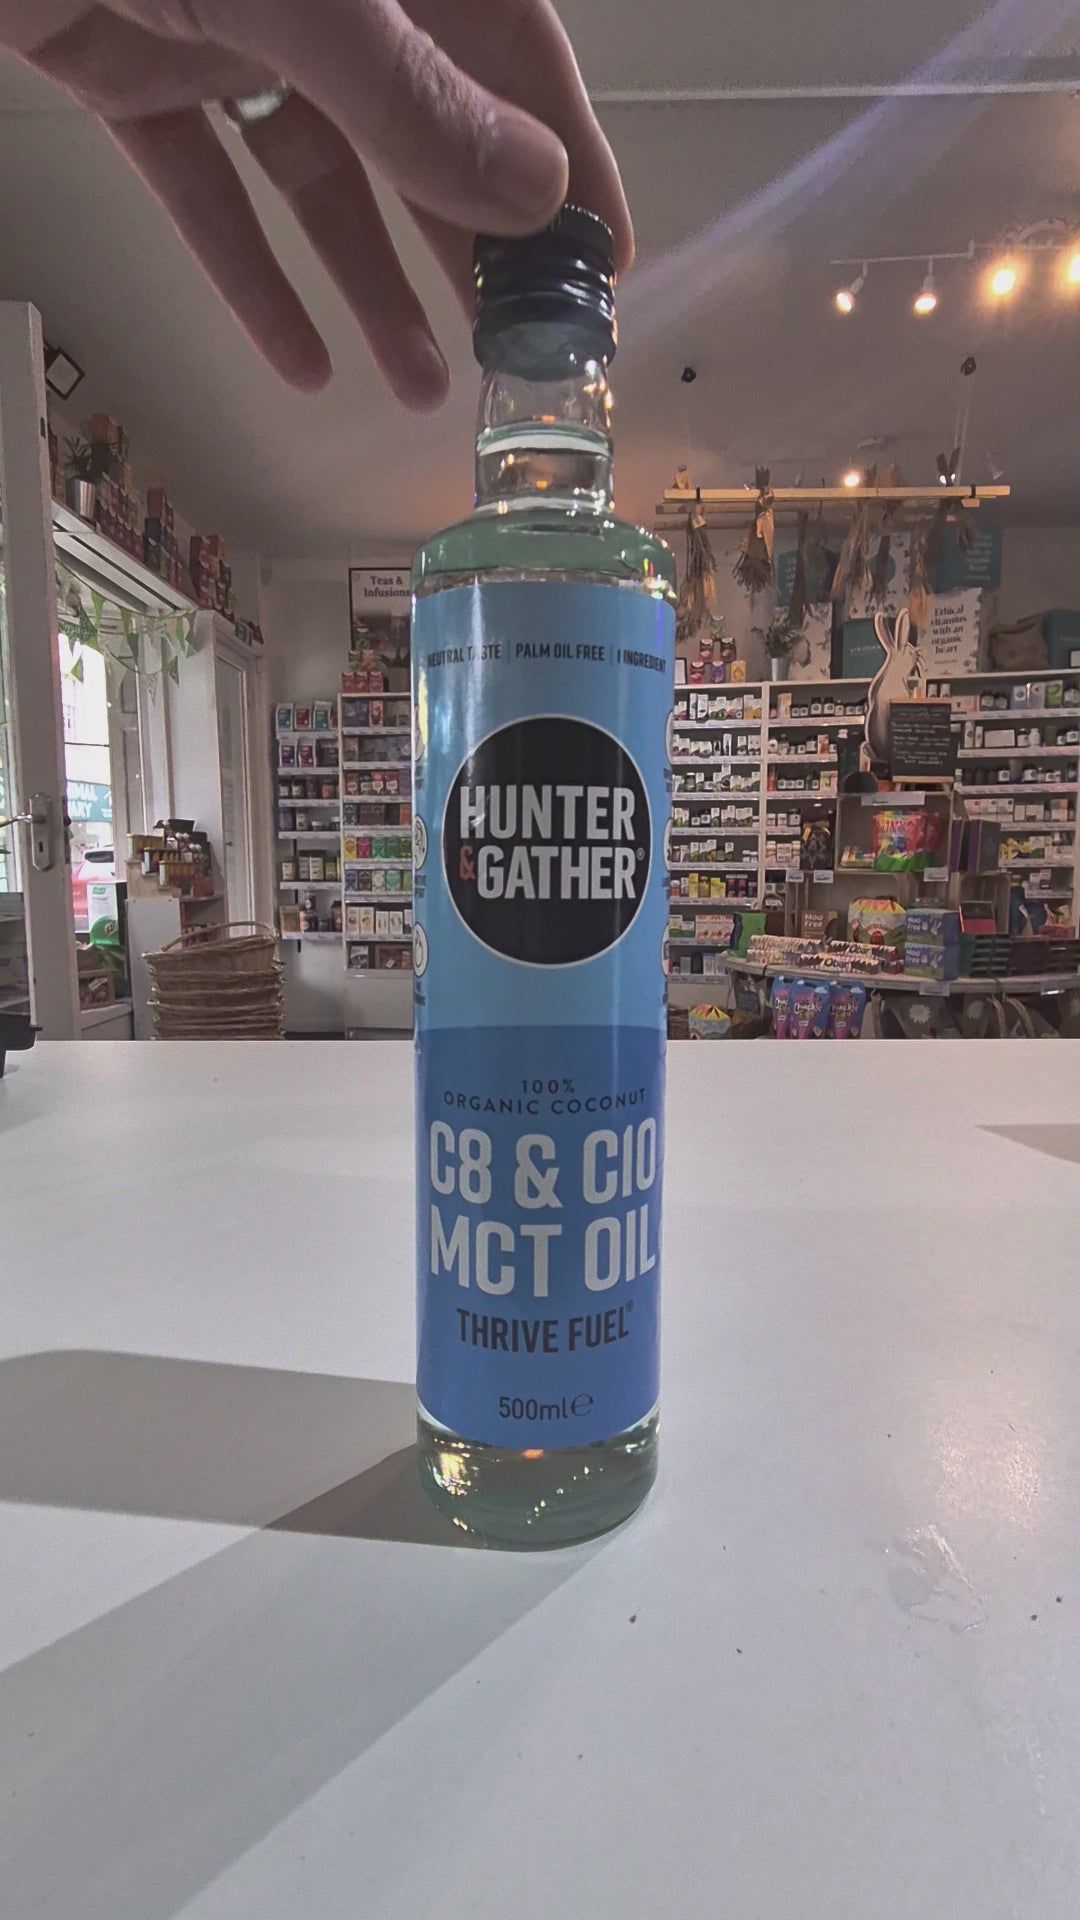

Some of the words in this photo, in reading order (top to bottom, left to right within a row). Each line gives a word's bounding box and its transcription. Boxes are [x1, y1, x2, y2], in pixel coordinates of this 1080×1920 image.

[370, 576, 394, 585] Teas
[396, 576, 403, 585] &
[363, 587, 410, 597] Infusions
[934, 604, 964, 616] Ethical
[931, 615, 967, 626] vitamins
[932, 626, 951, 635] with
[953, 626, 964, 634] an
[931, 635, 962, 646] organic
[935, 645, 958, 654] heart
[427, 647, 464, 668] NEUTRAL
[515, 643, 550, 658] PALM
[553, 644, 573, 659] OIL
[576, 645, 605, 662] FREE
[623, 649, 666, 673] INGREDIENT
[460, 784, 635, 841] HUNTER
[522, 1078, 575, 1094] 100%
[443, 1090, 539, 1115] ORGANIC
[551, 1088, 646, 1115] COCONUT
[430, 1120, 492, 1204] C8
[514, 1133, 563, 1209] &
[583, 1117, 656, 1204] C10
[431, 1204, 562, 1297] MCT
[585, 1204, 656, 1292] OIL
[456, 1307, 559, 1353] THRIVE
